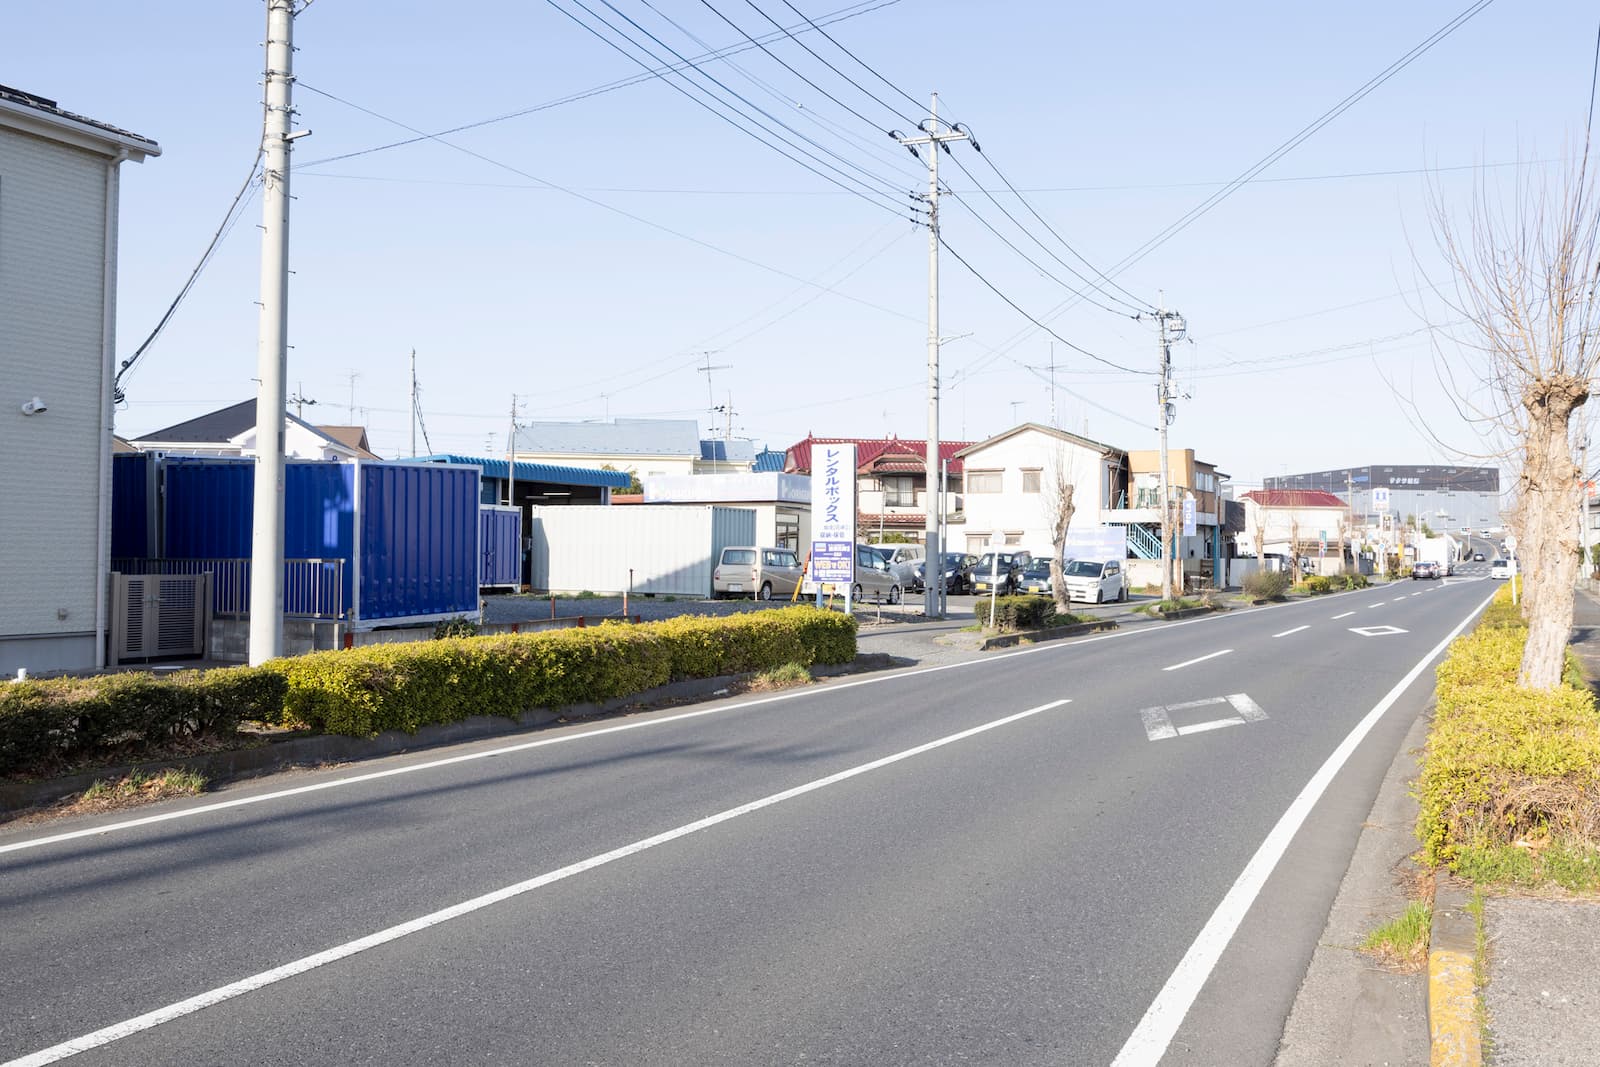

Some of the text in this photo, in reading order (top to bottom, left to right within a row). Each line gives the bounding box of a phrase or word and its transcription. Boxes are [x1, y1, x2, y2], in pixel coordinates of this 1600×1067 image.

[825, 449, 840, 522] レンタルボックス
